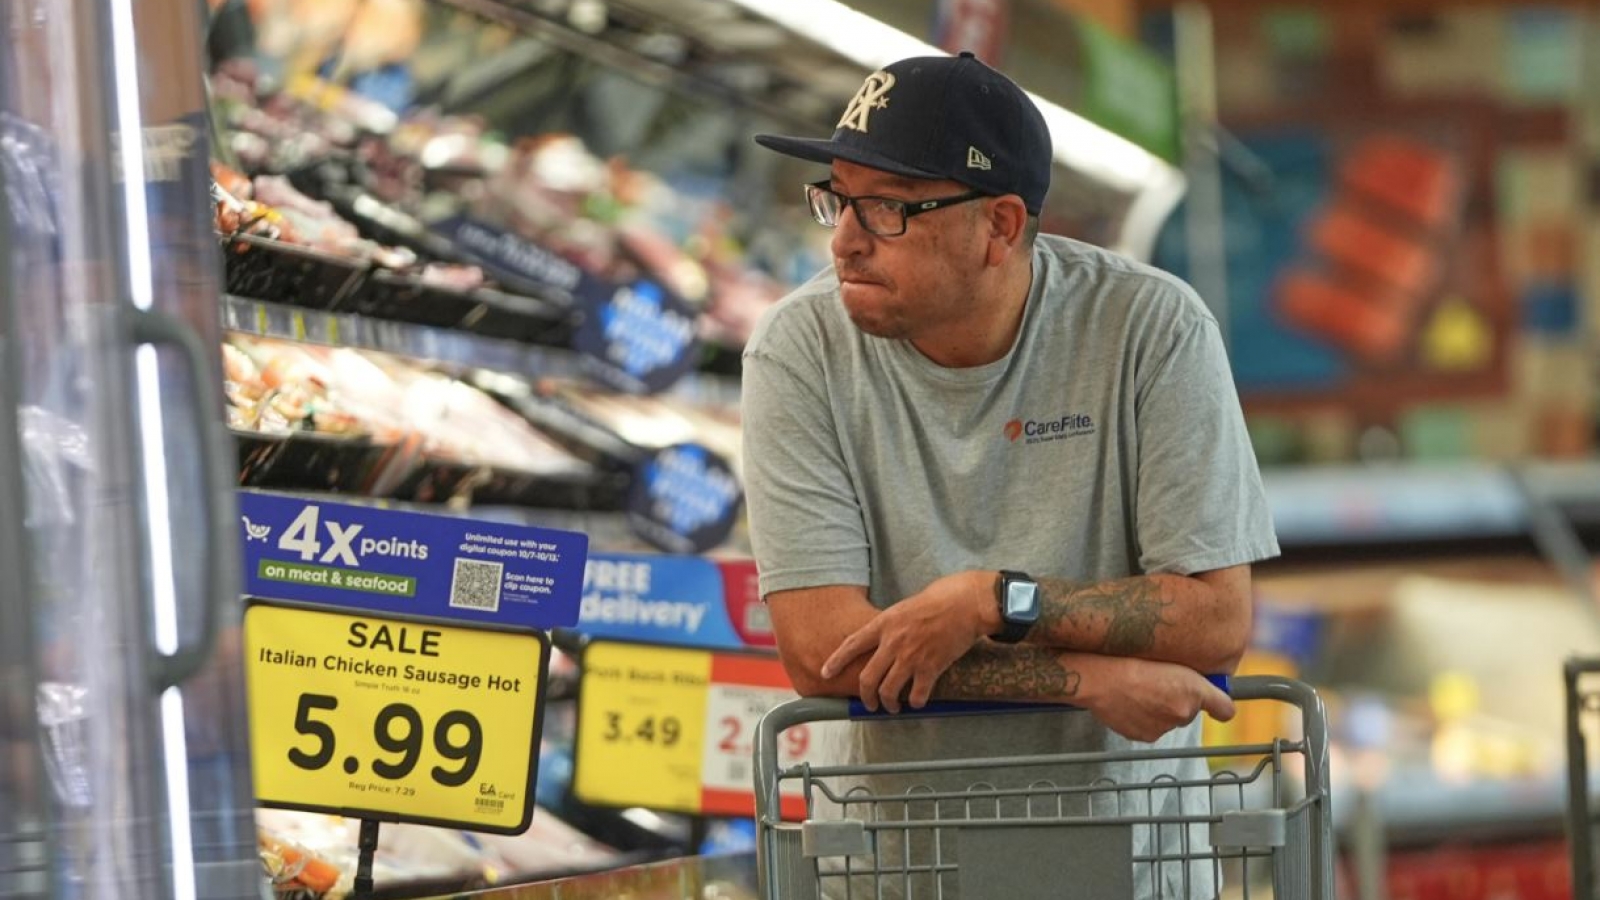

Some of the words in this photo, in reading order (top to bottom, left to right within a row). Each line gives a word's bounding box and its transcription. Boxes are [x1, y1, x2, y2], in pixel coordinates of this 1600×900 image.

[360, 536, 429, 560] points
[459, 543, 486, 553] digital
[487, 547, 517, 557] coupon
[465, 532, 504, 545] Unlimited
[504, 539, 518, 547] use
[520, 539, 537, 549] with
[538, 543, 557, 551] your
[265, 565, 286, 579] on
[289, 568, 328, 584] meat
[331, 571, 342, 585] &
[345, 575, 410, 593] seafood
[504, 581, 518, 591] clip
[505, 572, 525, 581] Scan
[526, 574, 544, 584] here
[545, 577, 555, 586] to
[583, 559, 651, 595] FREE
[347, 621, 442, 657] SALE
[259, 647, 317, 668] Italian
[323, 654, 397, 678] Chicken
[403, 664, 481, 690] Sausage
[487, 674, 521, 693] Hot
[288, 692, 483, 788] 5.99
[603, 711, 681, 747] 3.49
[718, 715, 811, 759] 2.9
[348, 781, 366, 791] Reg
